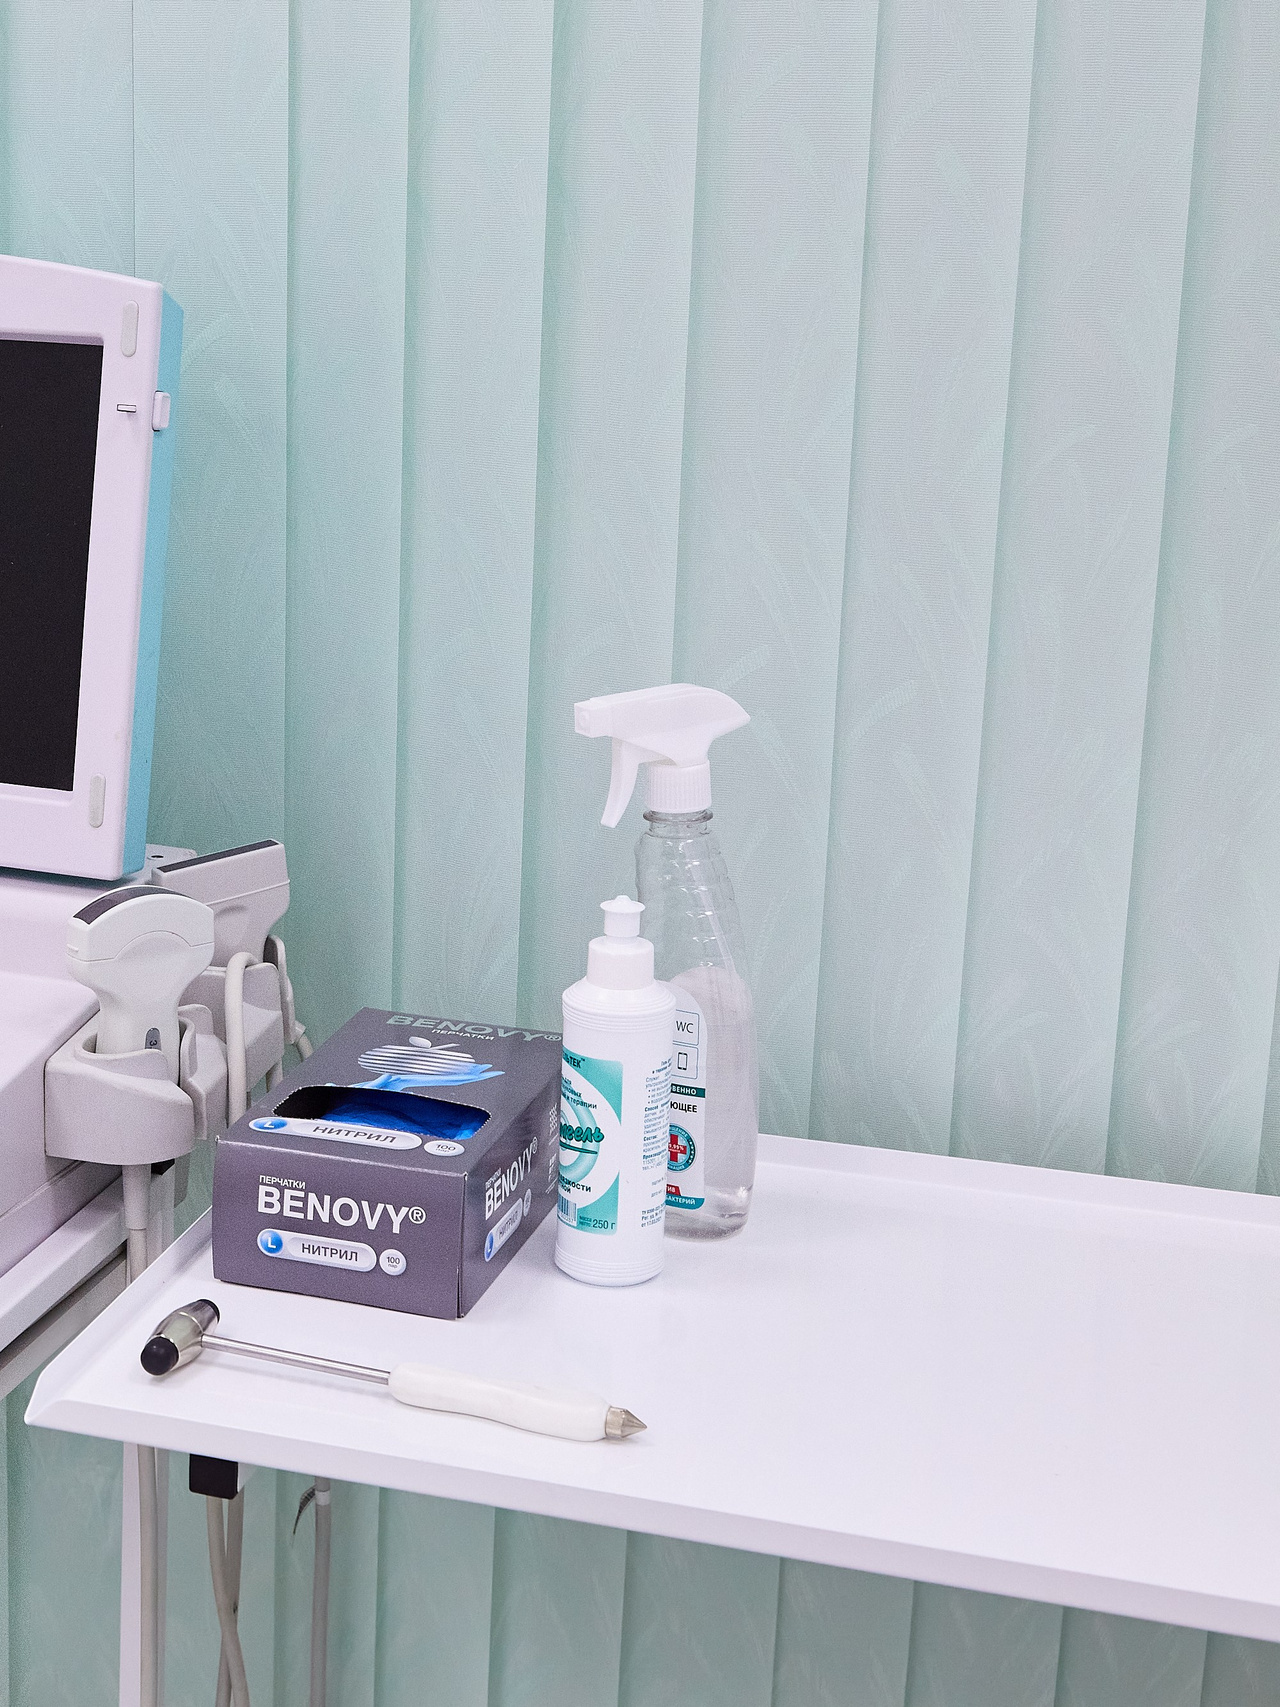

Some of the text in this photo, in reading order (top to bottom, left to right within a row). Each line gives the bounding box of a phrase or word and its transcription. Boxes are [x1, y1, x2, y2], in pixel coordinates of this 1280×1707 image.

[675, 1020, 694, 1034] WC
[432, 1028, 495, 1040] ПЕРЧАТКИ
[671, 1085, 697, 1095] ВЕННО
[670, 1100, 698, 1113] ЮЩЕЕ
[312, 1125, 397, 1143] НИТРИЛ
[435, 1143, 456, 1151] 100
[259, 1174, 306, 1190] ПЕРЧАТКИ
[667, 1195, 696, 1205] АКТЕРИЙ
[592, 1218, 609, 1230] 250
[267, 1236, 277, 1249] L
[301, 1243, 358, 1262] НИТРИЛ
[386, 1256, 401, 1265] 100
